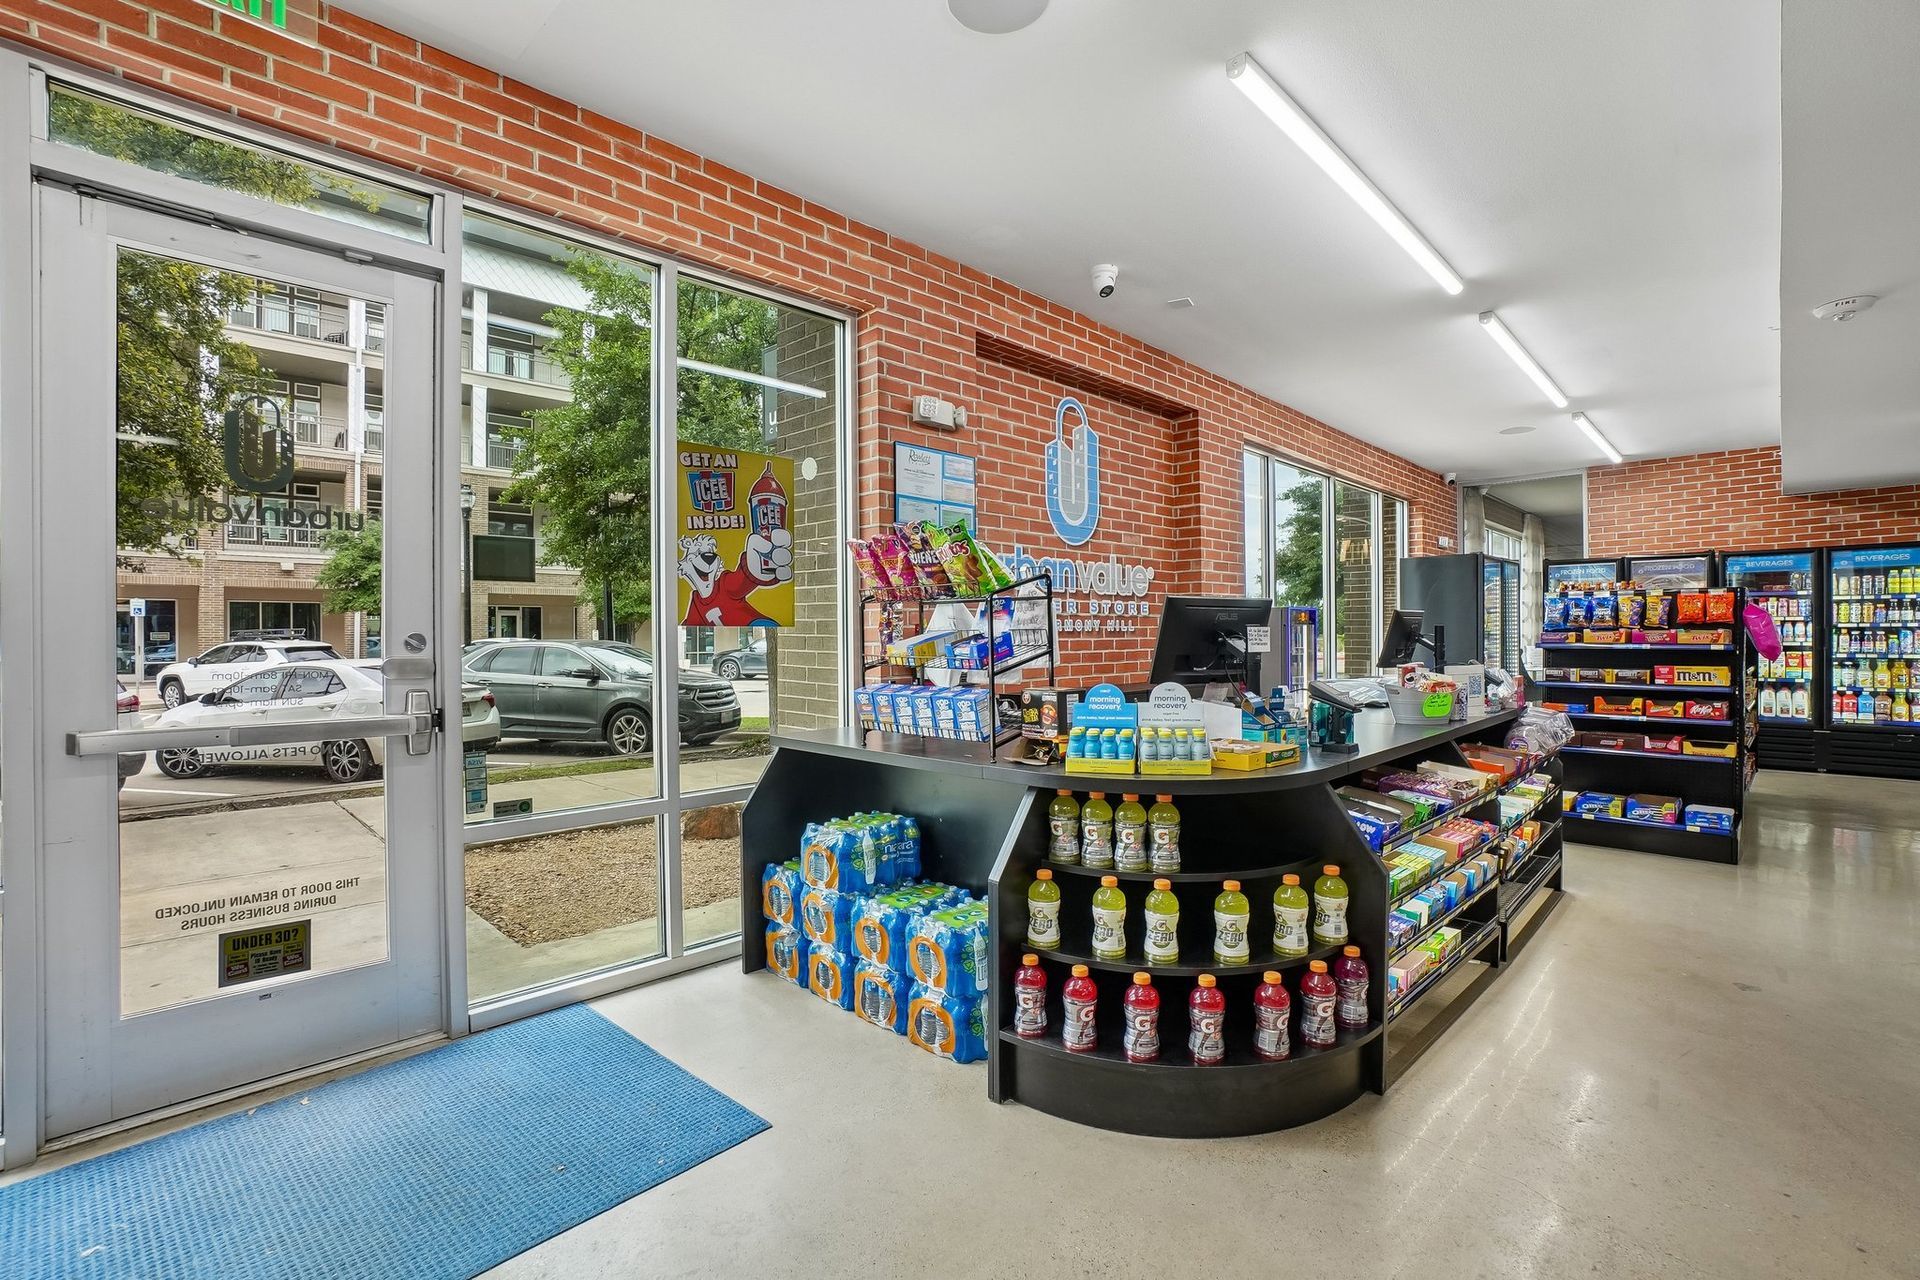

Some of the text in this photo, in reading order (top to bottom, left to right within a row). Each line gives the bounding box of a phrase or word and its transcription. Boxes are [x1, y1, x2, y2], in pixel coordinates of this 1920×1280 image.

[679, 452, 738, 469] GET AN
[695, 478, 729, 502] ICEE
[687, 514, 745, 530] INSIDE!
[757, 505, 782, 527] ICEE
[1745, 559, 1794, 568] BEVERAGES
[1855, 553, 1911, 562] BEVERAGES
[996, 544, 1150, 597] rbanvalue
[1560, 568, 1585, 576] FROZEN
[1089, 599, 1150, 616] STORE
[1055, 619, 1136, 633] RMONY HILL
[1089, 695, 1121, 704] morning
[1154, 694, 1187, 703] morning
[1050, 820, 1063, 836] G
[1084, 825, 1098, 840] G
[1154, 828, 1170, 844] G
[1121, 829, 1135, 844] G
[232, 932, 273, 951] UNDER
[275, 928, 299, 944] 30?
[1147, 929, 1174, 942] ZERO
[1217, 930, 1244, 942] ZERO
[1019, 994, 1034, 1009] G
[1317, 1001, 1334, 1018] G
[1080, 1006, 1095, 1022] G
[1134, 1015, 1151, 1031] G
[1200, 1018, 1215, 1034] G
